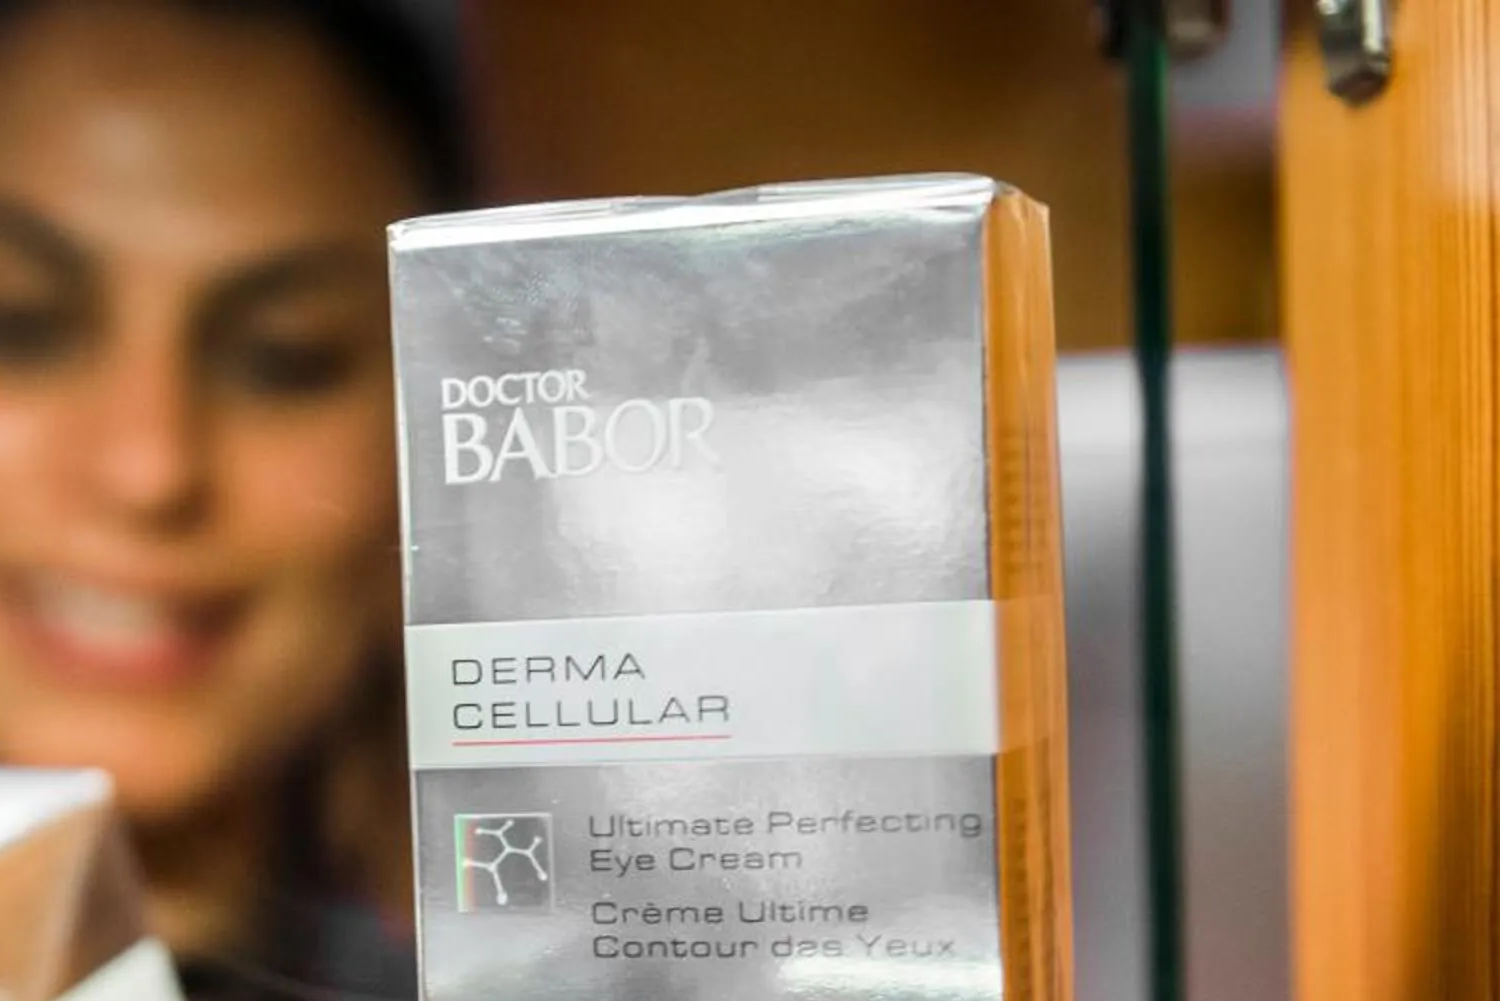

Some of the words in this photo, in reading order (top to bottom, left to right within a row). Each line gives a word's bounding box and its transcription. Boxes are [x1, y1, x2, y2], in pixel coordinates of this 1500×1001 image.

[441, 370, 590, 410] DOCTOR
[443, 397, 722, 485] BABOR
[452, 653, 646, 686] DERMA
[453, 696, 730, 731] CELLULAR
[589, 812, 755, 838] Ultimate
[768, 810, 983, 838] Perfecting
[591, 849, 656, 875] Eye
[669, 847, 802, 871] Cream
[592, 901, 724, 926] Crème
[738, 900, 870, 924] Ultime
[593, 935, 758, 960] Contour
[857, 934, 956, 958] Yeux
